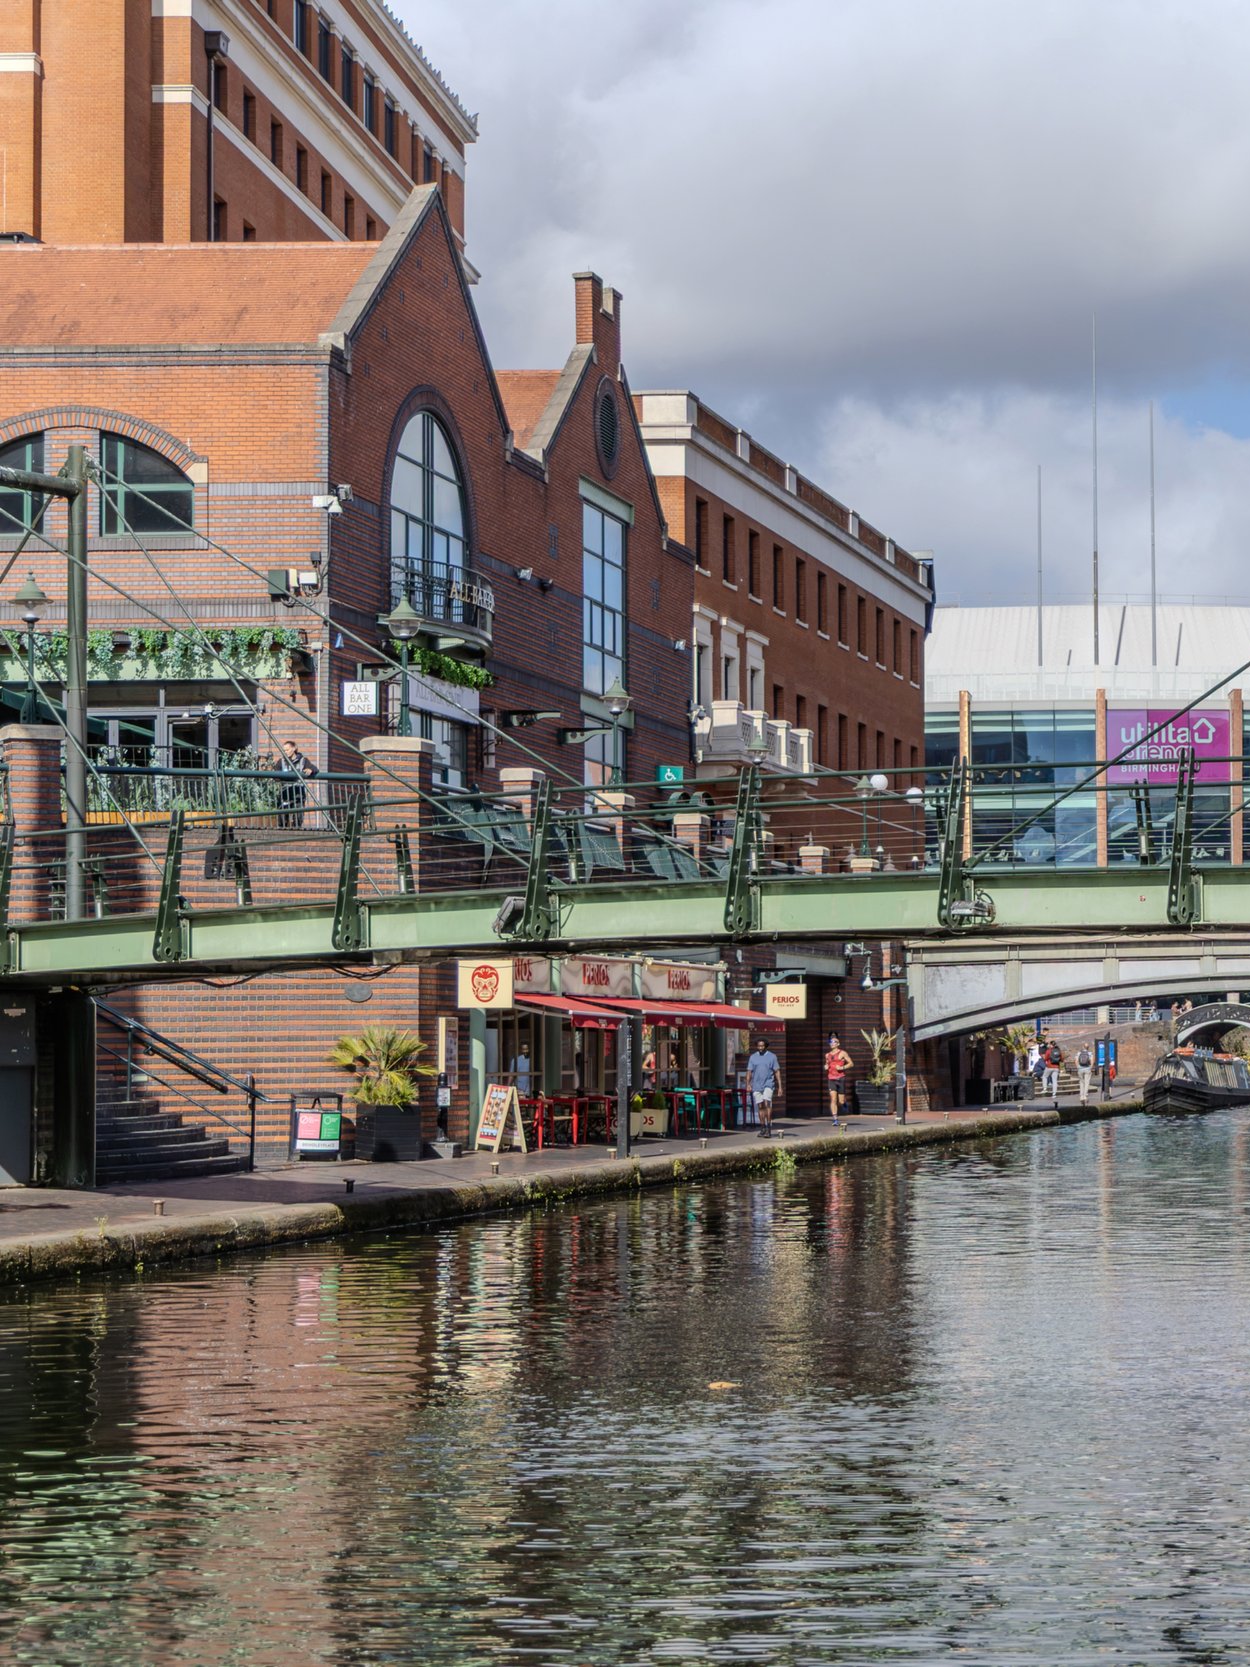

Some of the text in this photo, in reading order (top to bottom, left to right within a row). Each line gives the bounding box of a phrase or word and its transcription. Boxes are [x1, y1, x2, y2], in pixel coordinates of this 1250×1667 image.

[351, 684, 370, 693] ALL
[350, 694, 370, 703] BAR
[347, 704, 372, 713] ONE
[1121, 722, 1191, 743] utilita
[582, 963, 610, 986] PERIOS
[667, 970, 690, 990] PERIOS
